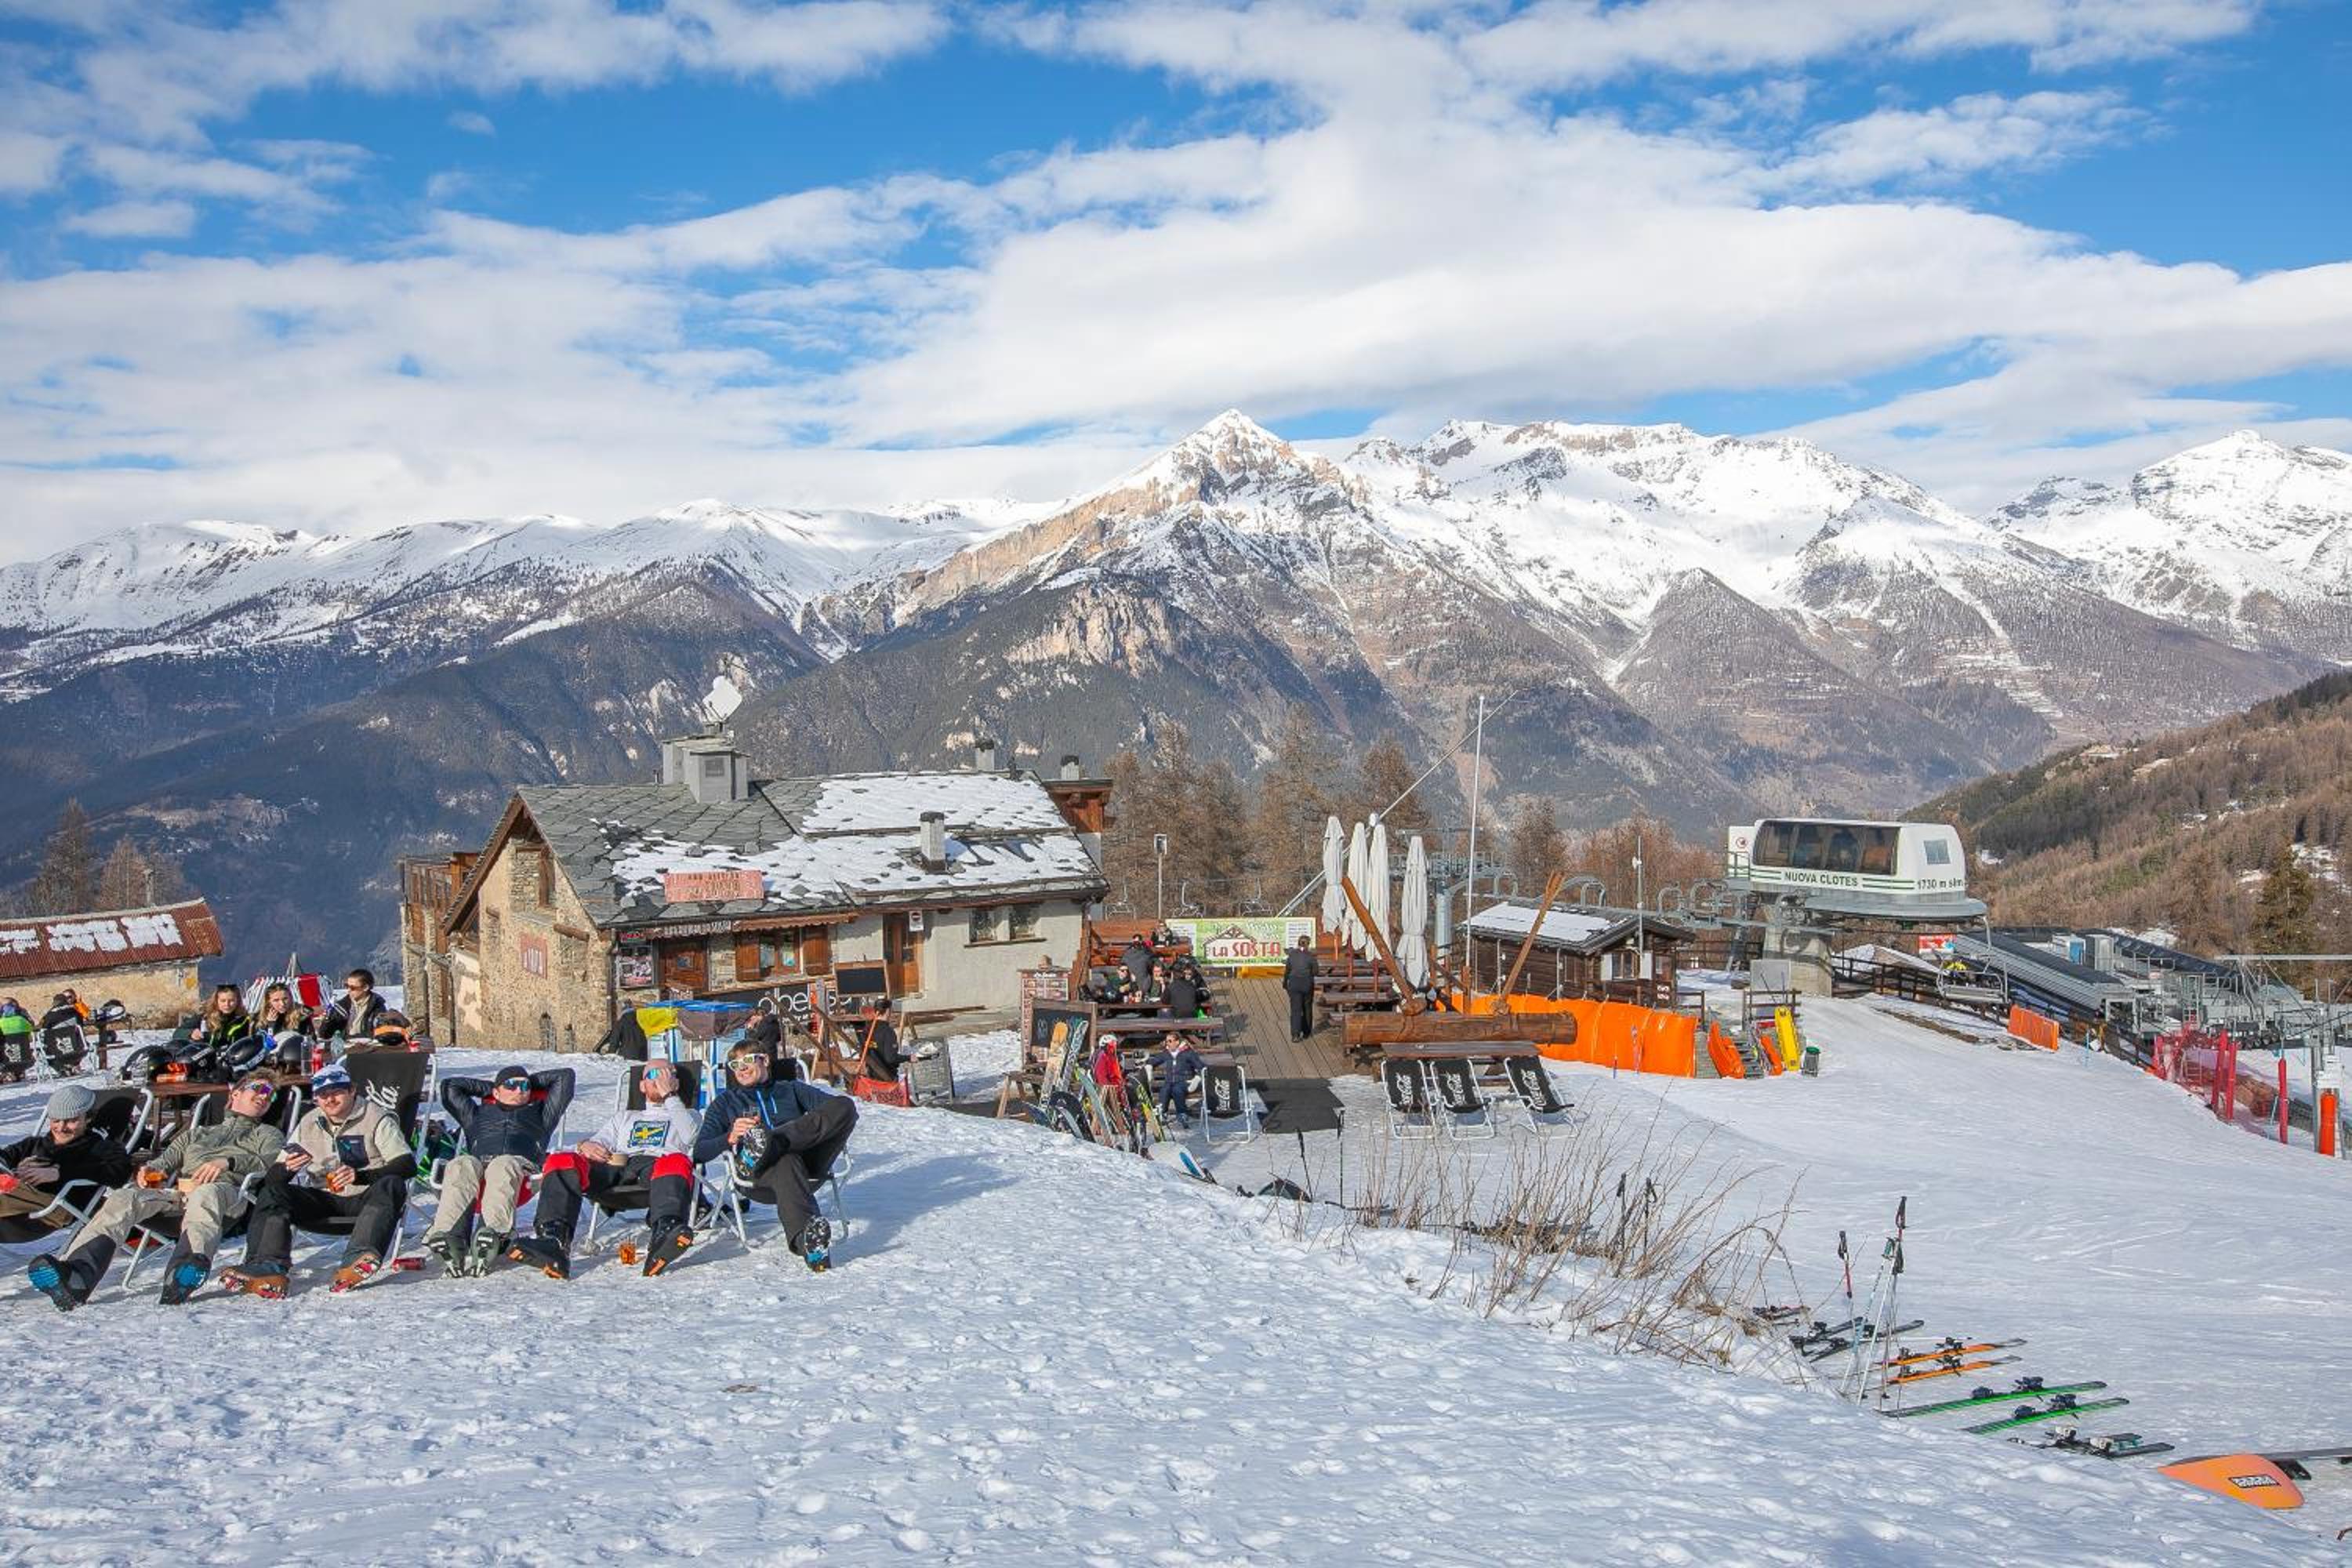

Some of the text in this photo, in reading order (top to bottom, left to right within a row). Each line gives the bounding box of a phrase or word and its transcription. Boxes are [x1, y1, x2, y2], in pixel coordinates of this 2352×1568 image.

[1784, 871, 1858, 887] NUOVA CLOTES
[1918, 878, 1937, 889] 1730
[1213, 942, 1280, 957] LA SOSTA
